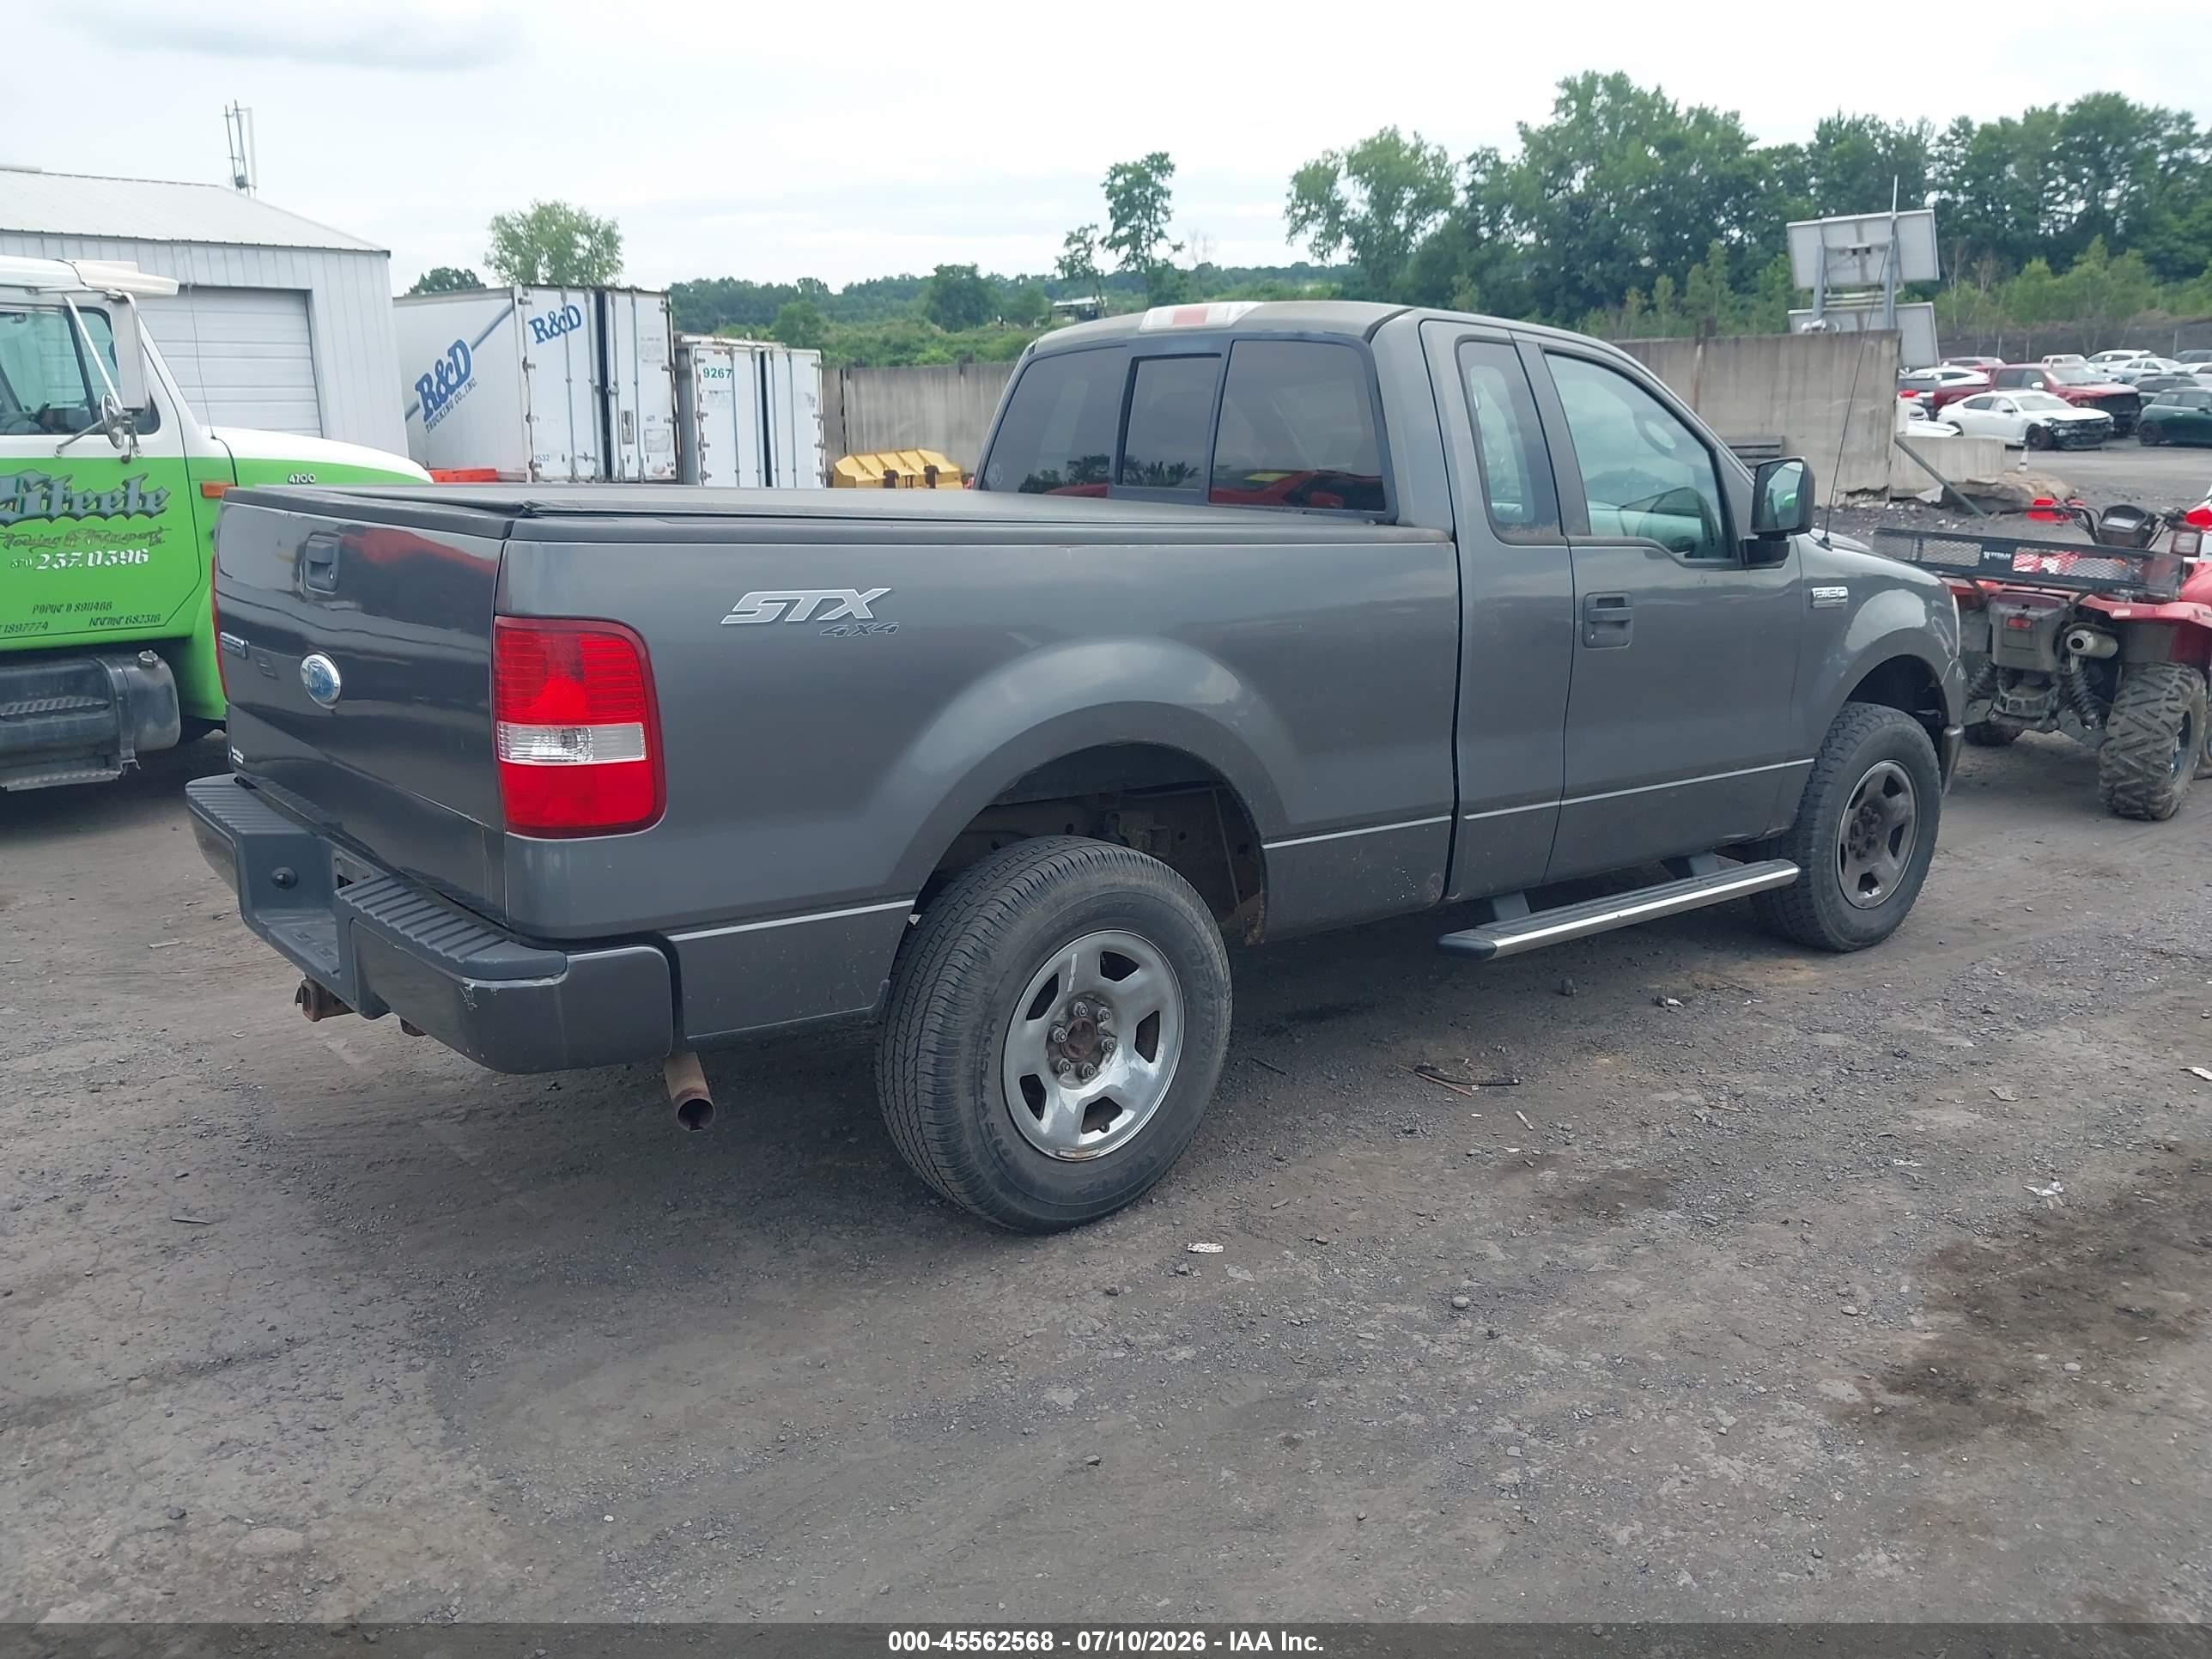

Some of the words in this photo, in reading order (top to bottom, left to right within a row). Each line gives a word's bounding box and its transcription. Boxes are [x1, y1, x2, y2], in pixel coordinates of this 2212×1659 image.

[527, 304, 582, 344] R&D
[415, 338, 471, 423] R&D
[702, 367, 733, 379] 9267
[288, 473, 316, 484] 4700
[720, 587, 892, 624] STX
